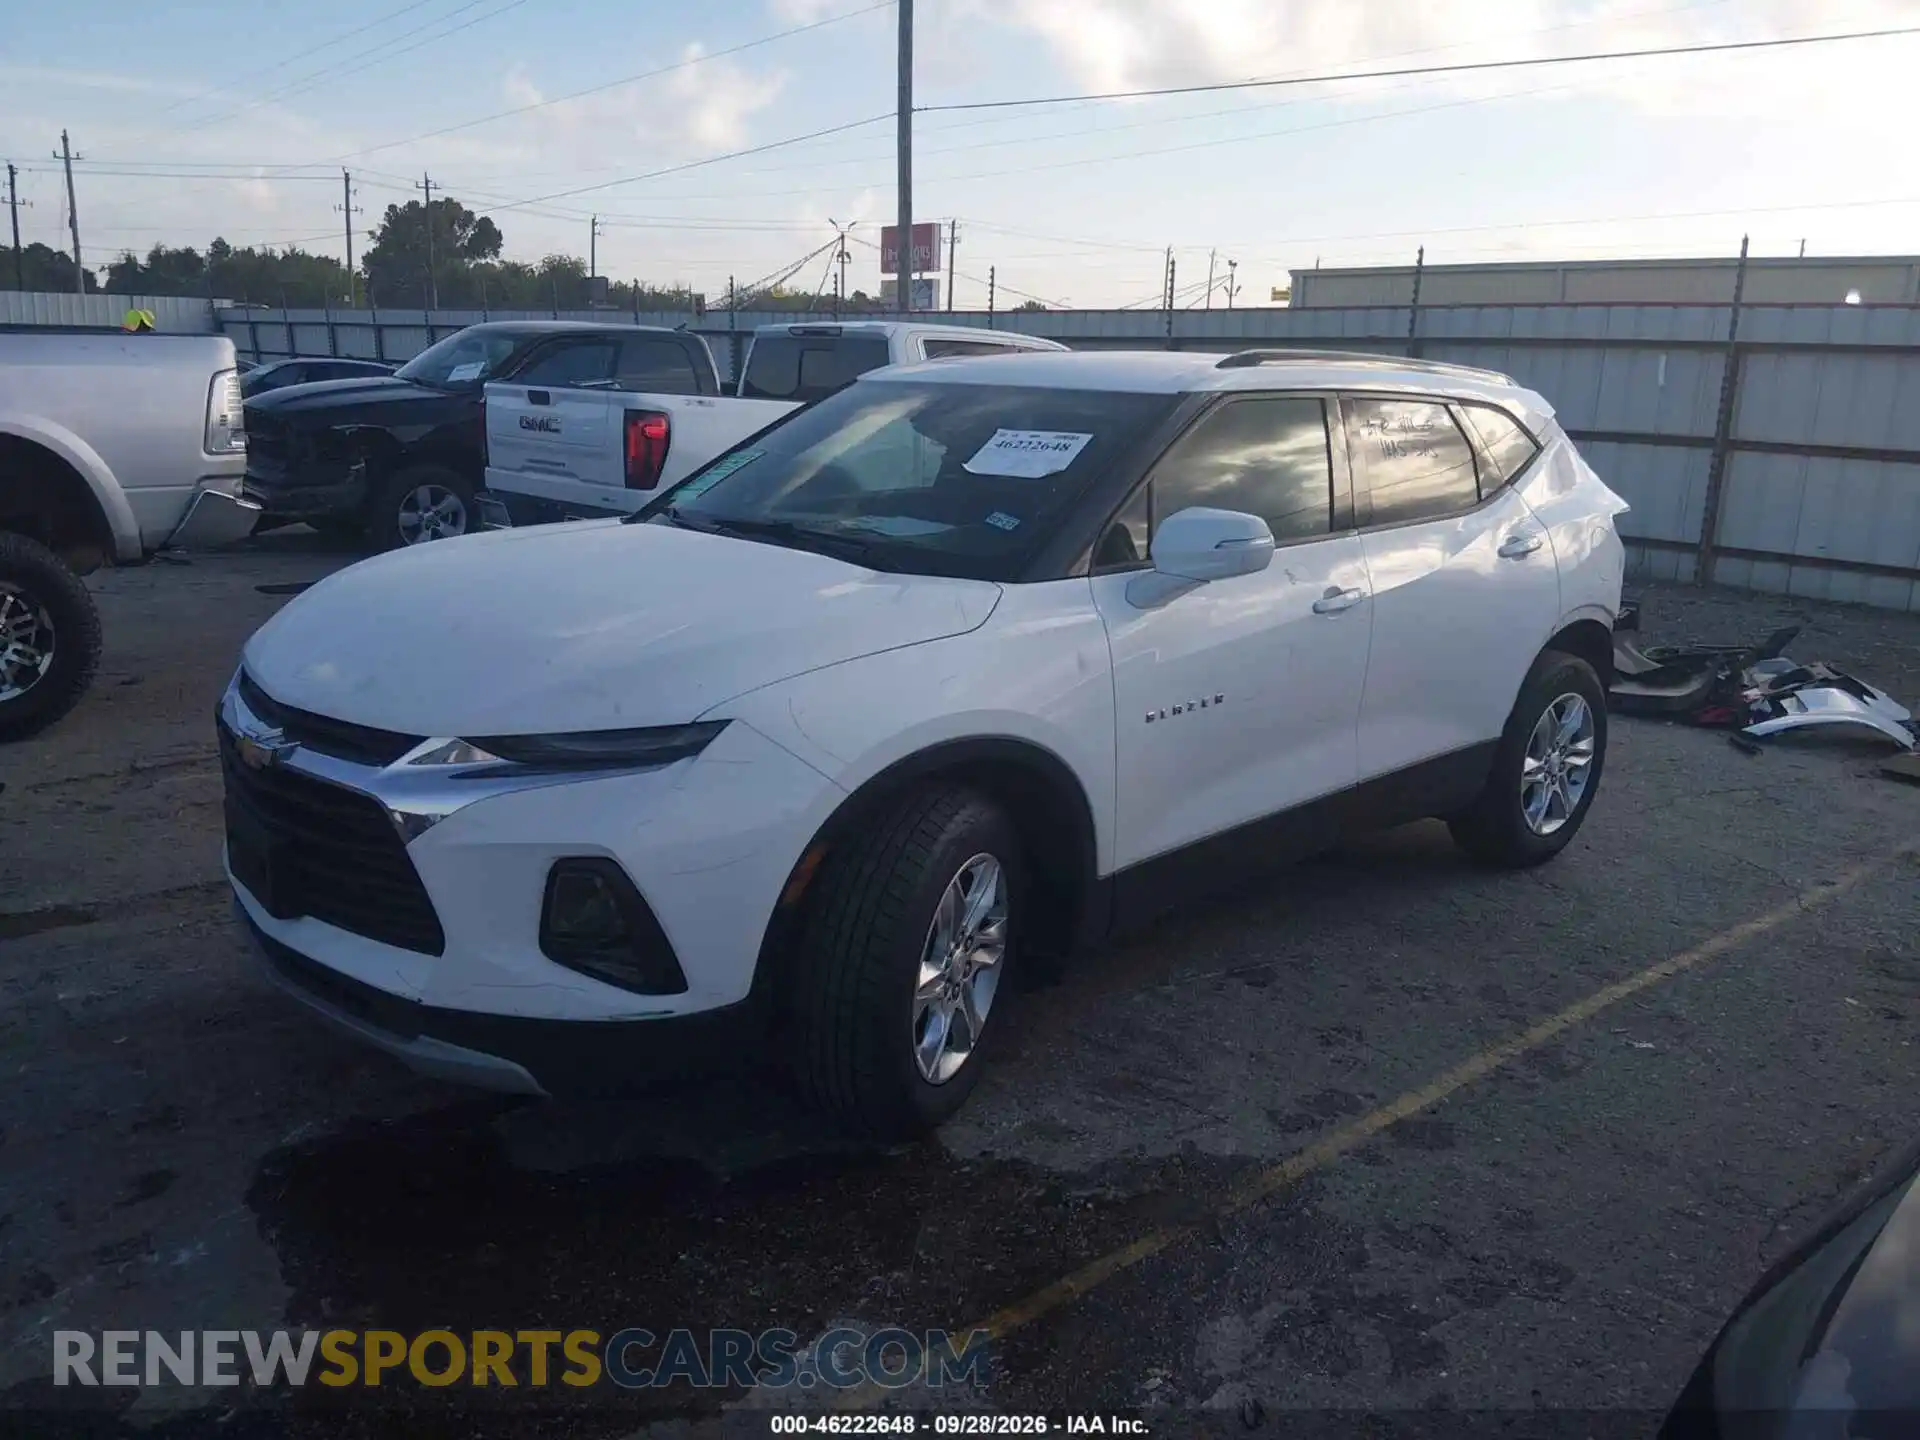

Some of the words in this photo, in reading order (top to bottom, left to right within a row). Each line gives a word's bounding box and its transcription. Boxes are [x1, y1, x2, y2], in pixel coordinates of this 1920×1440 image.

[519, 415, 562, 434] GMC
[994, 439, 1072, 452] 46222648
[1145, 692, 1225, 724] BLAZER
